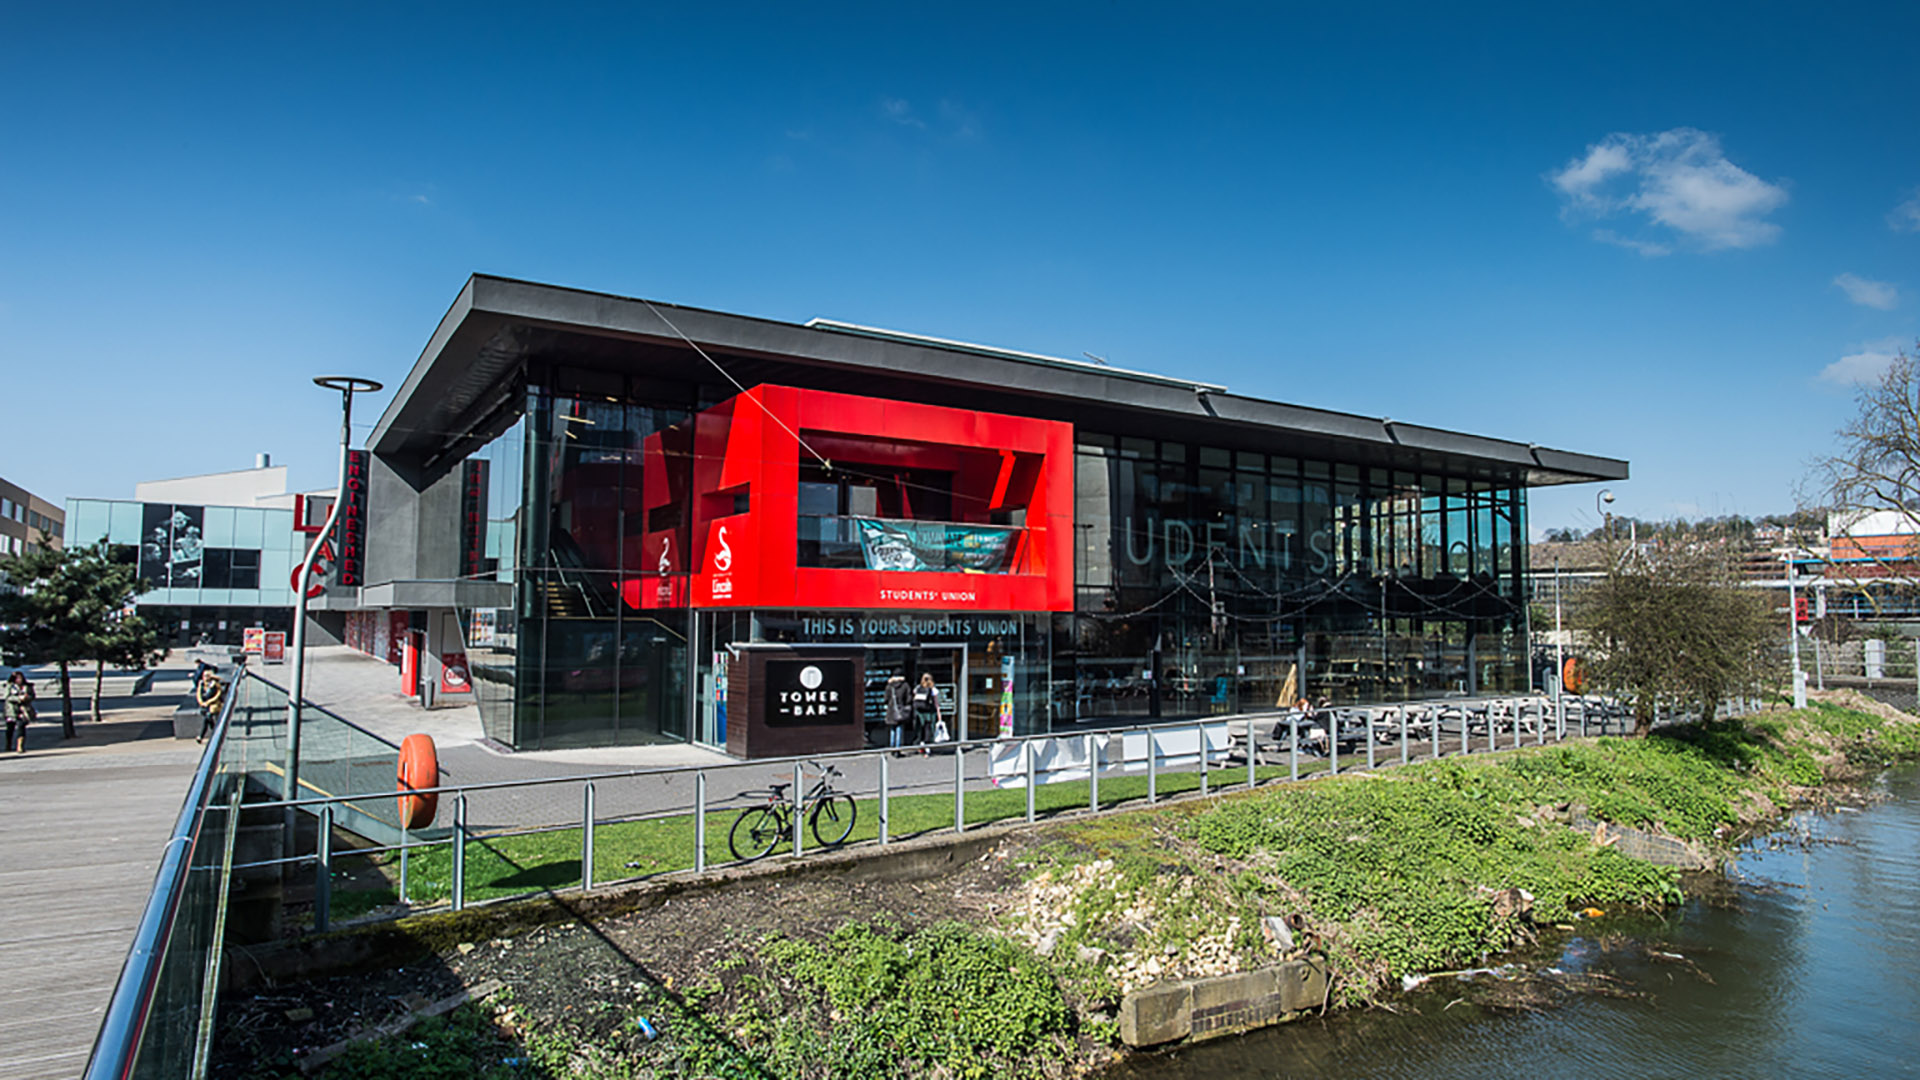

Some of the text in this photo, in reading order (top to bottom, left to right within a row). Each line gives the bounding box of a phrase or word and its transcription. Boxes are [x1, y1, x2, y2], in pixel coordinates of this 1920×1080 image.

[941, 591, 976, 601] UNION
[802, 617, 836, 635] THIS
[839, 617, 854, 635] IS
[859, 617, 898, 635] YOUR
[977, 618, 1018, 635] UNION
[779, 691, 840, 703] TOWER
[793, 705, 828, 716] BAR
